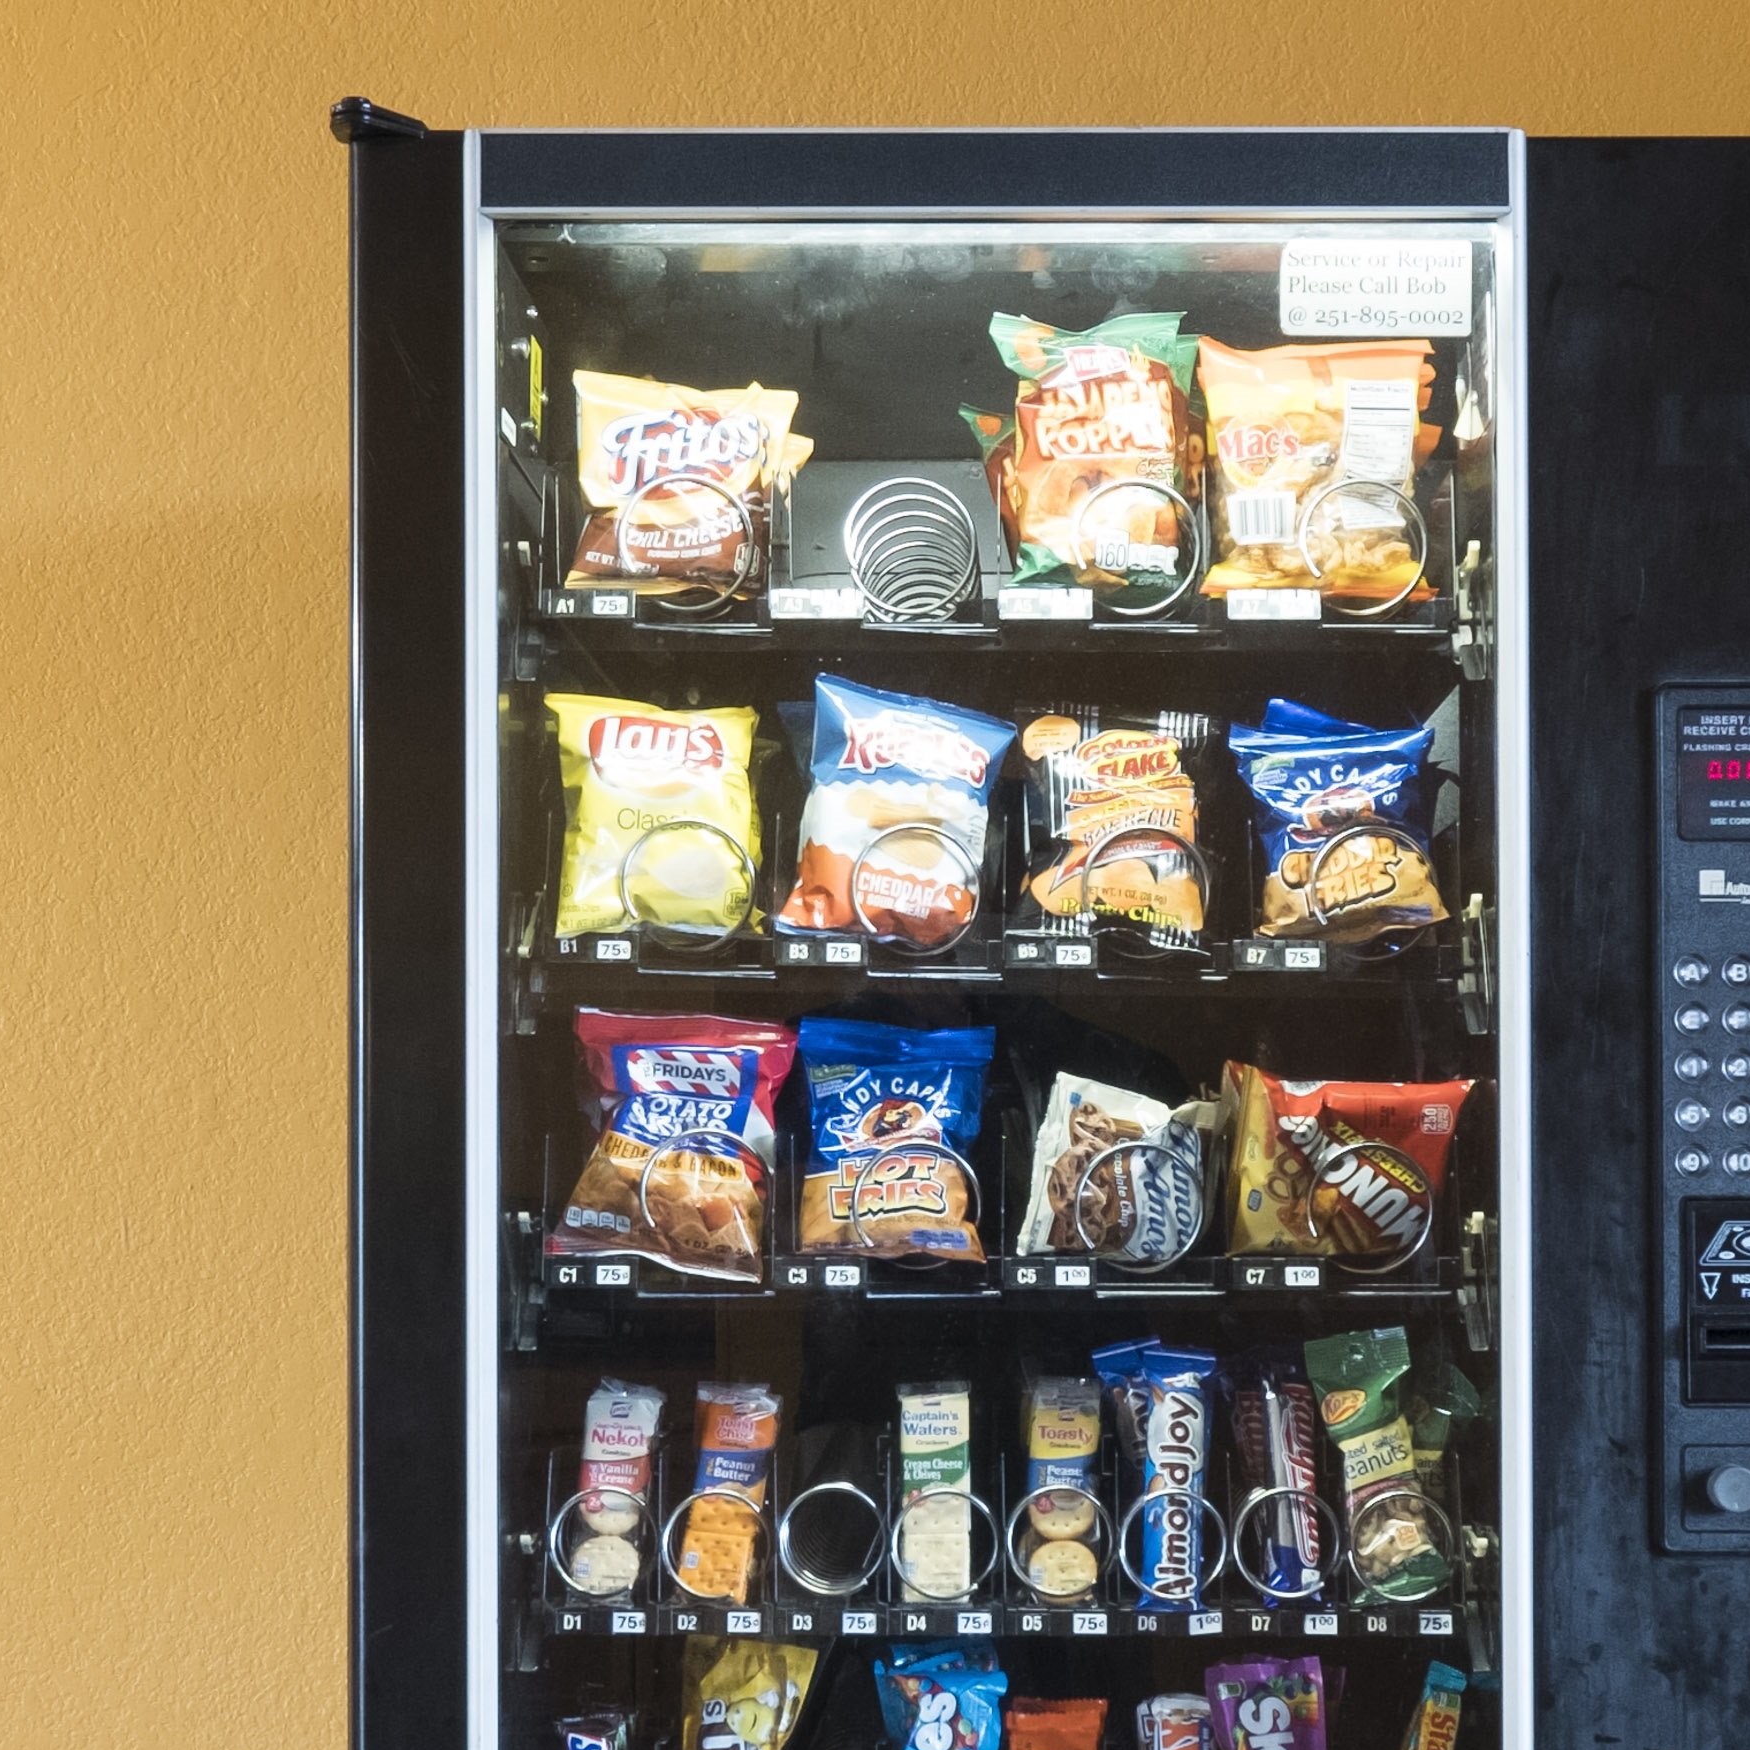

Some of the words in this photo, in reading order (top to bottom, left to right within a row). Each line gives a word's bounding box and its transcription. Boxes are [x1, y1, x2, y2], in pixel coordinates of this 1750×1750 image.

[1287, 251, 1361, 267] Service
[1368, 255, 1388, 267] or
[1399, 251, 1465, 271] Repair
[1288, 276, 1352, 294] Please
[1359, 275, 1397, 294] Call
[1407, 276, 1446, 294] Bob
[1288, 306, 1307, 326] @
[1315, 306, 1463, 327] 251-895-0002
[602, 409, 760, 495] Fritos
[1216, 427, 1300, 463] Mac's
[556, 600, 575, 614] A1
[1701, 716, 1745, 725] INSERT
[1684, 726, 1736, 735] RECEIVE
[1097, 751, 1171, 778] FLAKE
[1710, 817, 1728, 825] USE
[858, 871, 935, 907] CHEDDAR
[1128, 906, 1184, 929] Chips
[560, 939, 578, 953] B1
[789, 943, 809, 959] B3
[1017, 943, 1038, 958] B5
[1246, 949, 1267, 964] B7
[653, 1062, 726, 1083] FRIDAYS
[689, 1156, 737, 1178] BACON
[842, 1155, 937, 1186] HOT
[830, 1181, 946, 1220] FRIES
[1140, 1149, 1171, 1259] Amos
[559, 1266, 577, 1283] C1
[788, 1268, 807, 1284] C3
[1017, 1269, 1037, 1284] C5
[1246, 1269, 1265, 1285] C7
[902, 1410, 959, 1422] Captain's
[903, 1423, 958, 1436] Wafers
[1038, 1425, 1093, 1444] Toasty
[1159, 1395, 1199, 1460] Joy
[591, 1428, 645, 1447] Nekot
[599, 1463, 639, 1476] Vanilla
[715, 1456, 756, 1473] Peanut
[903, 1459, 931, 1469] Cream
[932, 1458, 963, 1469] Cheese
[1344, 1443, 1409, 1480] eanuts
[598, 1474, 635, 1485] Creme
[713, 1468, 752, 1482] Butter
[1153, 1462, 1195, 1596] Almond
[563, 1614, 582, 1631] D1
[677, 1614, 697, 1631] D2
[792, 1614, 813, 1631] D3
[906, 1615, 926, 1631] D4
[1022, 1615, 1042, 1631] D5
[1138, 1615, 1158, 1631] D6
[1251, 1616, 1271, 1632] D7
[1367, 1616, 1387, 1632] D8
